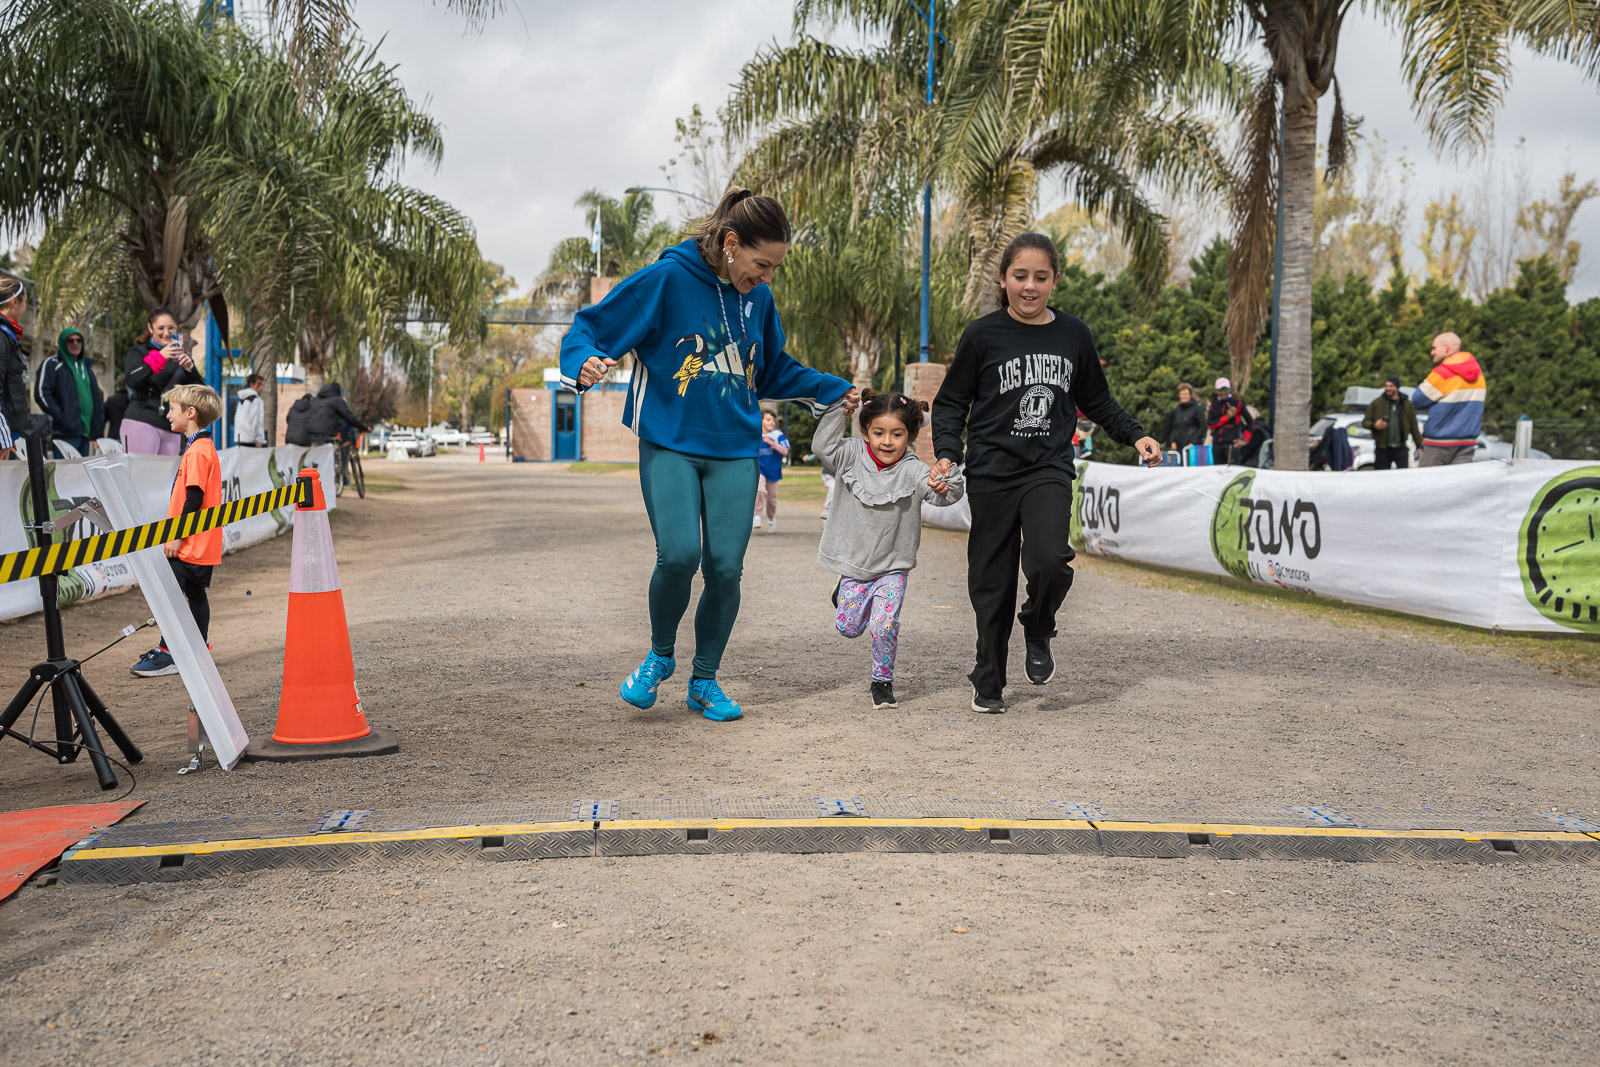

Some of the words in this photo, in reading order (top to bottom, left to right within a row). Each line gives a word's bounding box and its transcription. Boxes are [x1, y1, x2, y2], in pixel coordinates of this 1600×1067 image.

[998, 357, 1022, 395] LOS
[1024, 353, 1074, 394] ANGELES
[1029, 398, 1048, 416] LA
